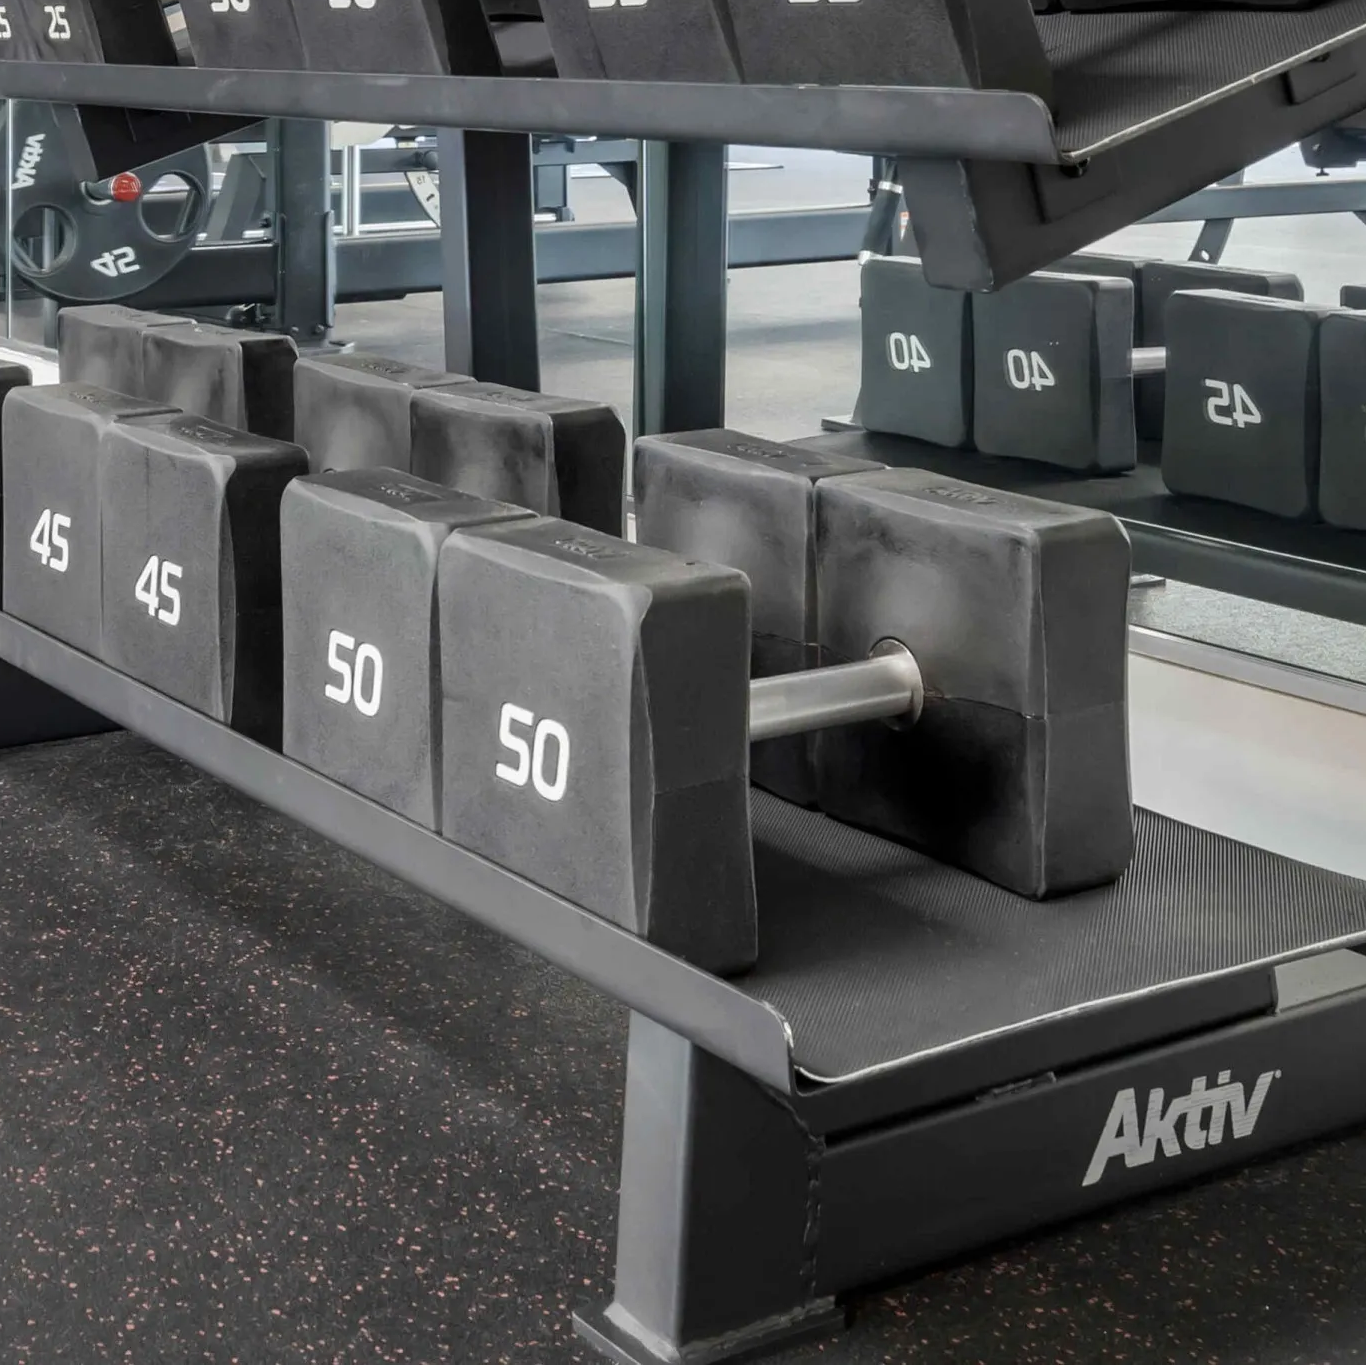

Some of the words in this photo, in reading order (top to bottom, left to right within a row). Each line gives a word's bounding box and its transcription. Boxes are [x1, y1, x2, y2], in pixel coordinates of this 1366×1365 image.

[43, 5, 71, 40] 25
[29, 508, 72, 573] 45
[134, 555, 184, 626] 45
[324, 629, 384, 718] 50
[495, 701, 571, 802] 50
[1081, 1069, 1278, 1187] Aktiv
